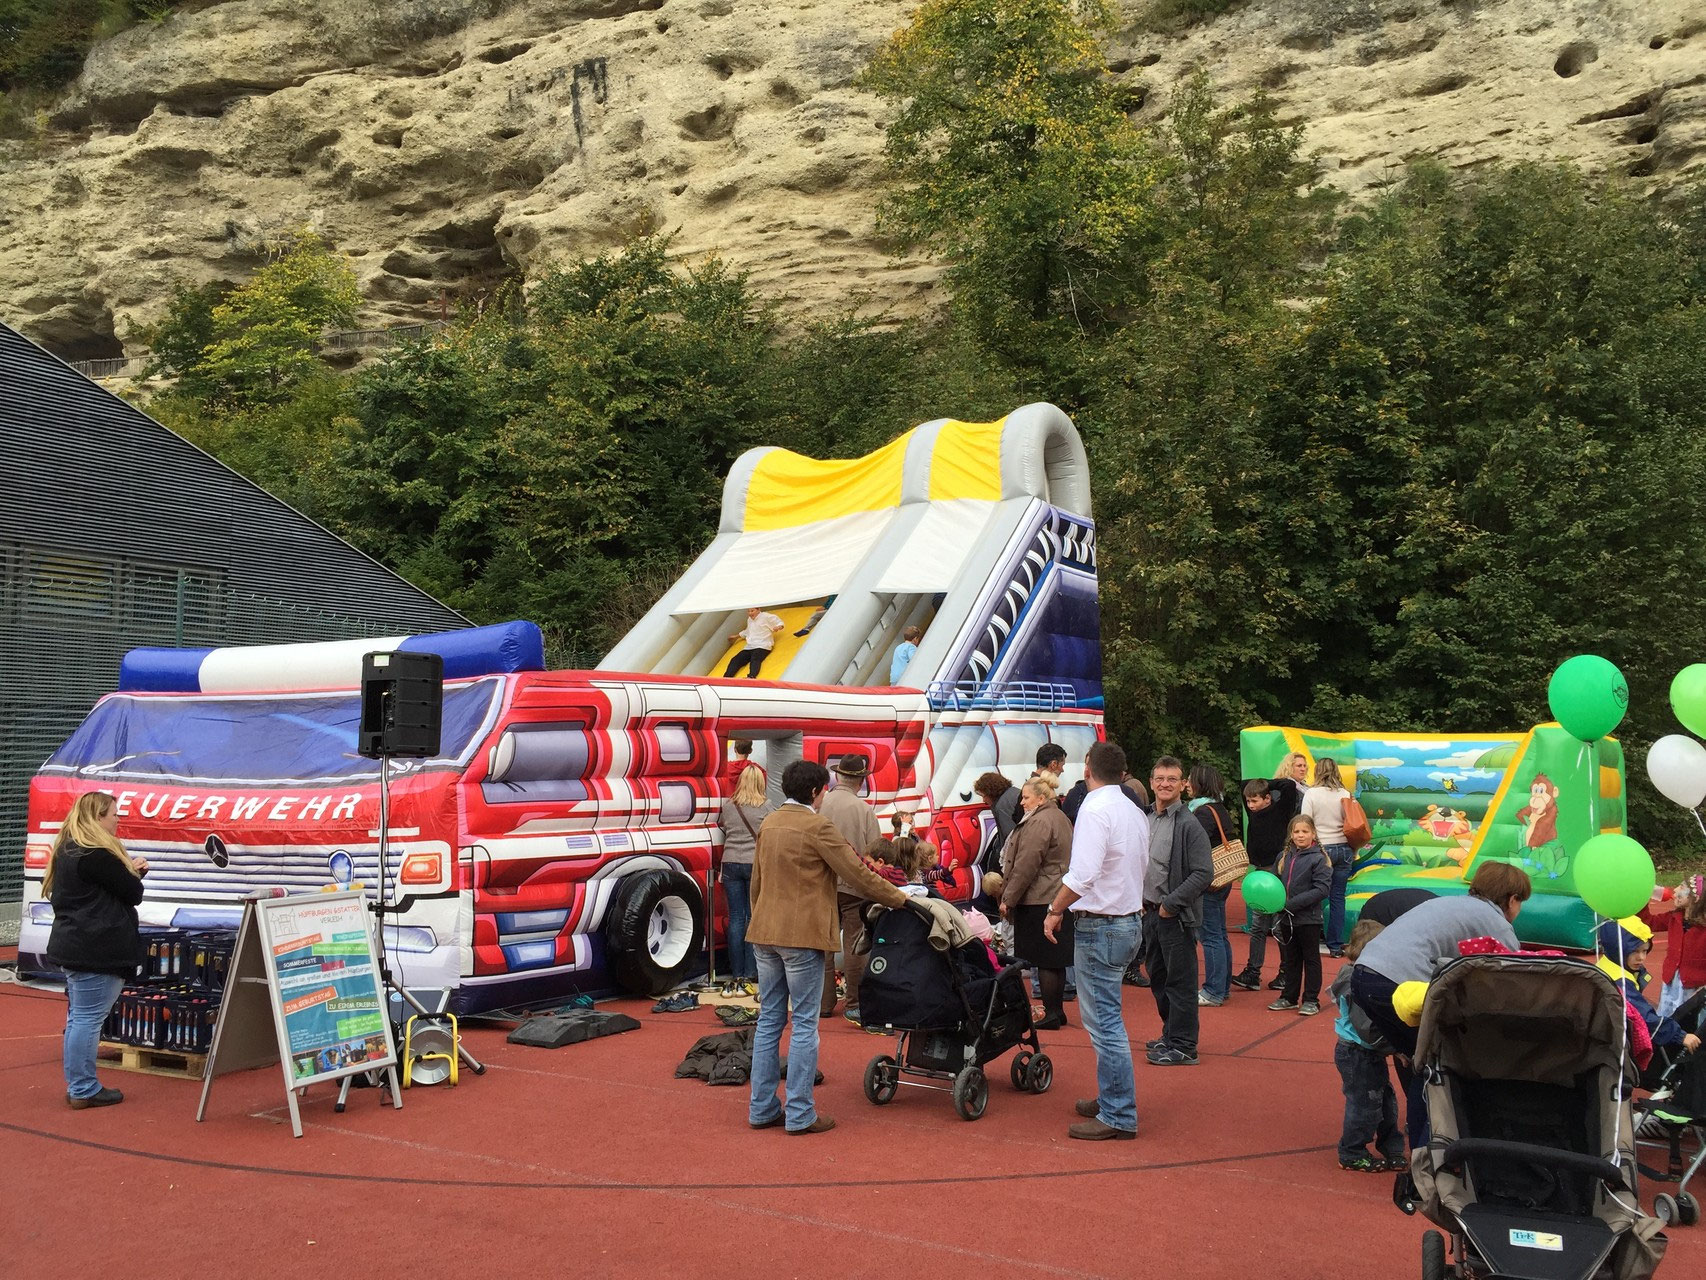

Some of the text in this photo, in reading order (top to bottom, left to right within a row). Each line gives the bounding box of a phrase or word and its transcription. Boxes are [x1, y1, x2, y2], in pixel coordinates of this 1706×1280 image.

[98, 789, 362, 821] EUERWEHR
[283, 958, 316, 968] SOMMERFESTE
[286, 1003, 298, 1012] ZUM
[299, 992, 332, 1008] GEBURTSTAG
